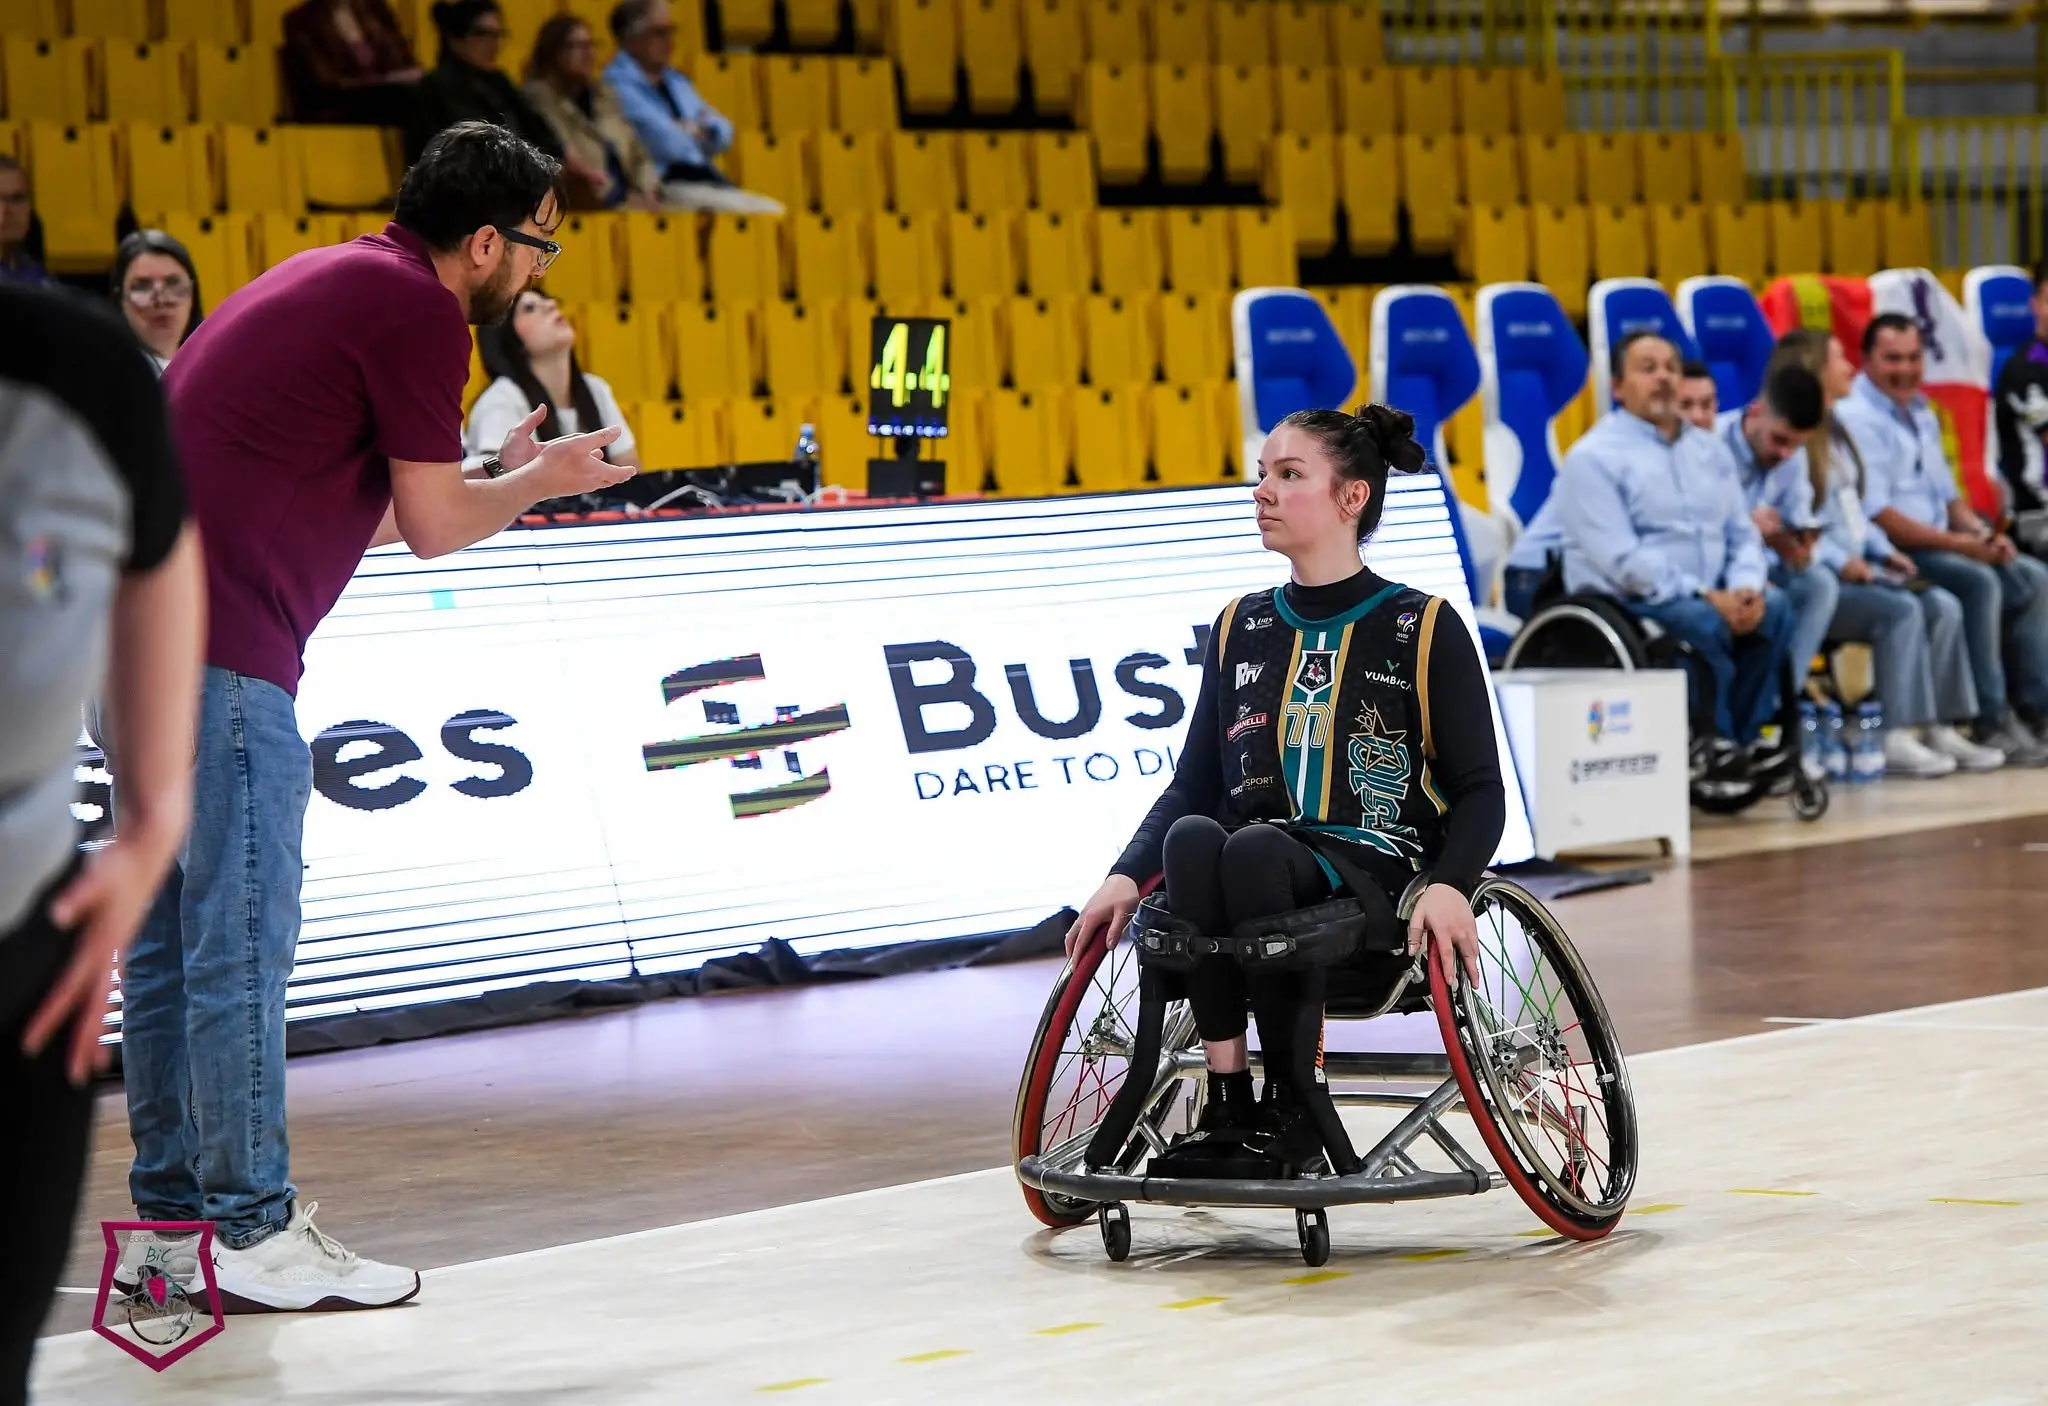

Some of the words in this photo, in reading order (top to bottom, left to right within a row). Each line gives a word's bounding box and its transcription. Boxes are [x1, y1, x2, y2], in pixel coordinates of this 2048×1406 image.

[1284, 701, 1332, 749] 77
[913, 760, 1038, 800] DARE
[1052, 752, 1119, 784] TO
